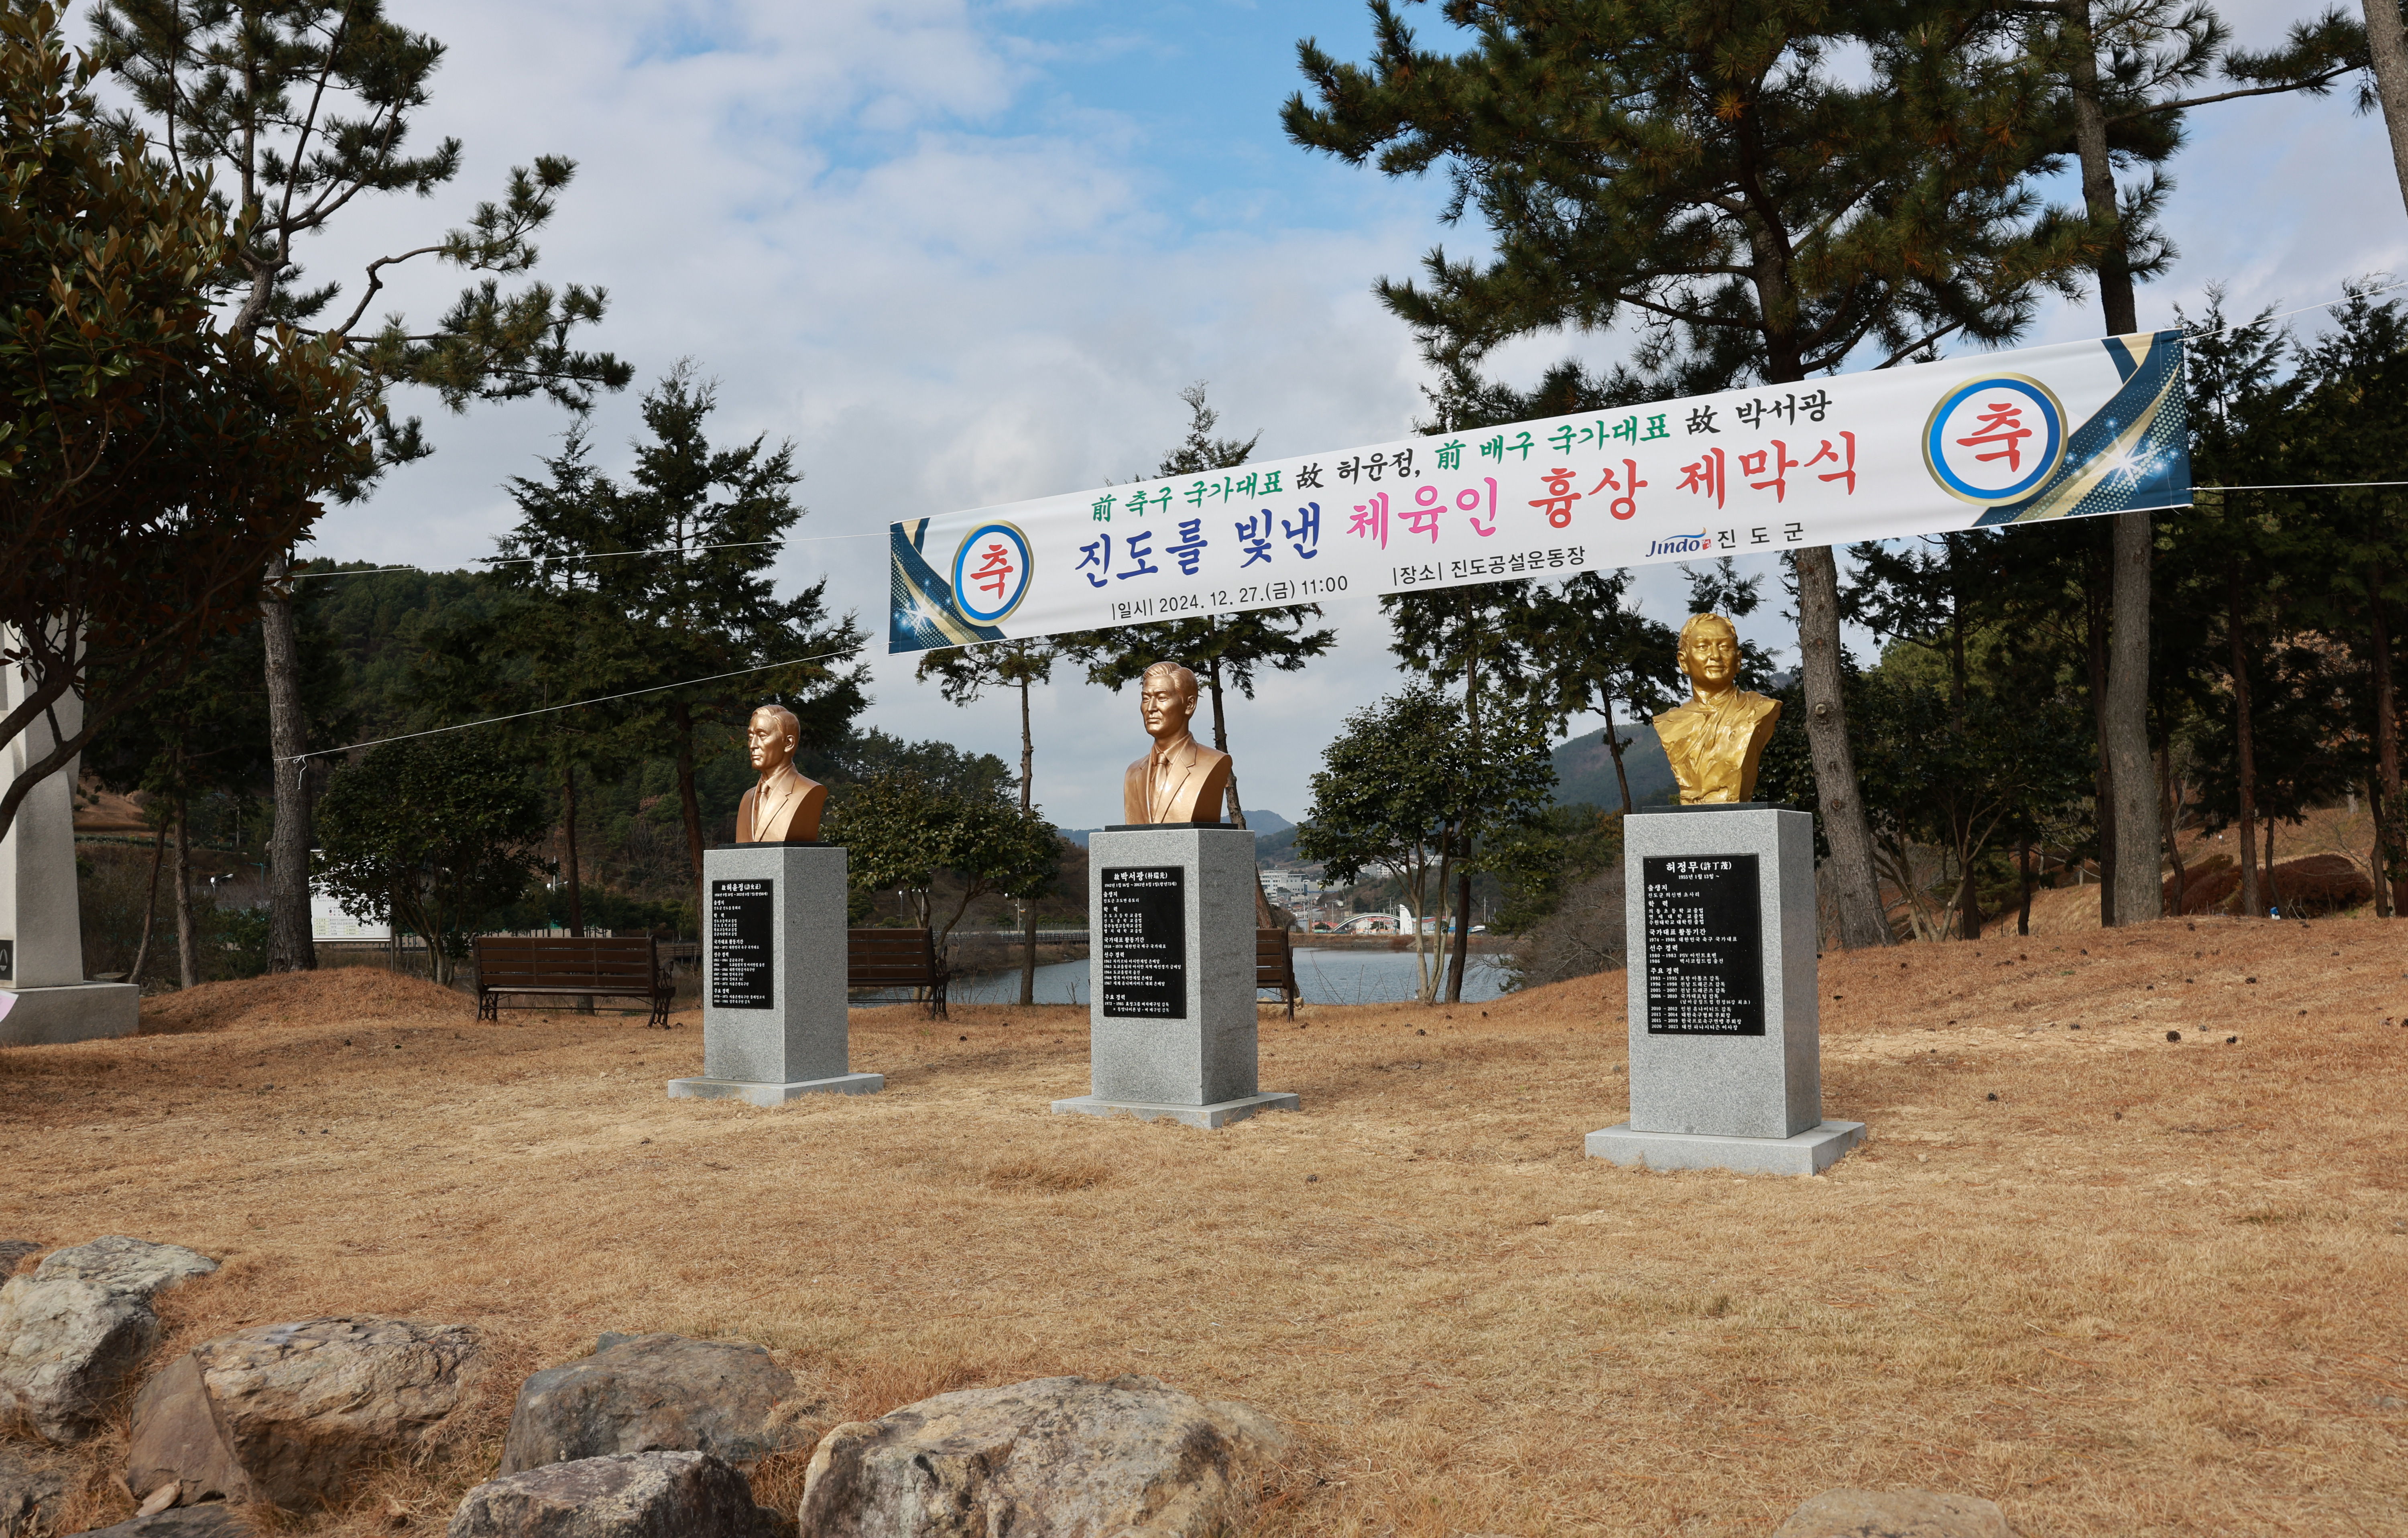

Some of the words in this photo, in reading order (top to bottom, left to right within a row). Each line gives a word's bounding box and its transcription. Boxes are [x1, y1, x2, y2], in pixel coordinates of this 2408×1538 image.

[1092, 494, 1117, 522] 前
[1126, 487, 1172, 517] 축구
[1184, 471, 1282, 508] 국가대표
[1296, 463, 1324, 489] 故
[1337, 449, 1420, 484] 허윤정,
[1435, 442, 1462, 470] 前
[1480, 432, 1534, 464] 배구
[1548, 414, 1670, 455] 국가대표
[1686, 405, 1714, 434] 故
[1736, 390, 1832, 429] 박서광
[1956, 402, 2032, 473] 축
[1075, 518, 1208, 588] 진도를
[1235, 502, 1320, 568] 빛낸
[1346, 477, 1498, 550] 체육인
[1528, 458, 1647, 528] 흉상
[1676, 431, 1856, 509] 제막식
[970, 544, 1013, 600] 축
[1451, 546, 1585, 578] 진도공설운동장
[1160, 595, 1204, 612] 2024.
[1211, 591, 1232, 606] 12.
[1302, 576, 1347, 594] 11:00
